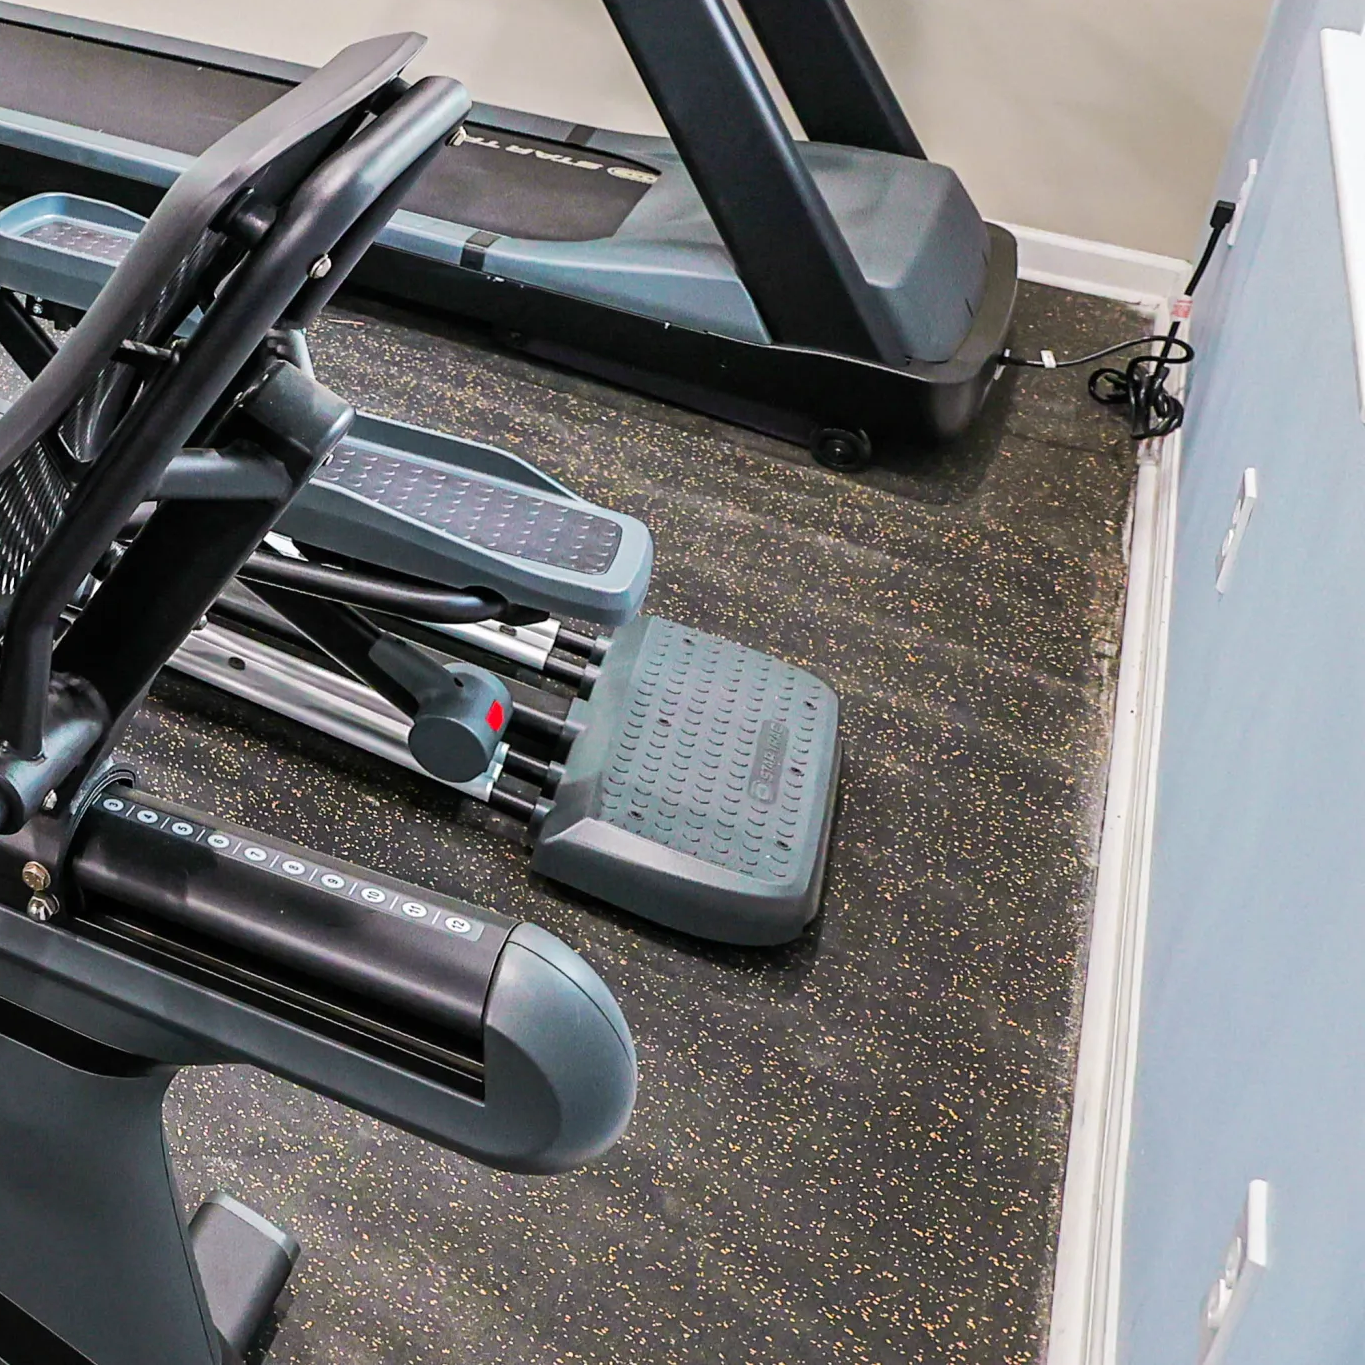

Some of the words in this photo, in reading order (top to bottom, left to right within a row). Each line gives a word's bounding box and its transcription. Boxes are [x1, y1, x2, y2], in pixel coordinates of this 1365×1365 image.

[505, 144, 604, 170] STAR
[108, 799, 120, 810] 3
[142, 812, 154, 822] 4
[176, 824, 189, 834] 5
[249, 849, 262, 859] 7
[288, 863, 301, 873] 8
[327, 876, 340, 887] 9
[365, 888, 381, 902] 10
[407, 904, 422, 917] 11
[450, 917, 465, 931] 12
